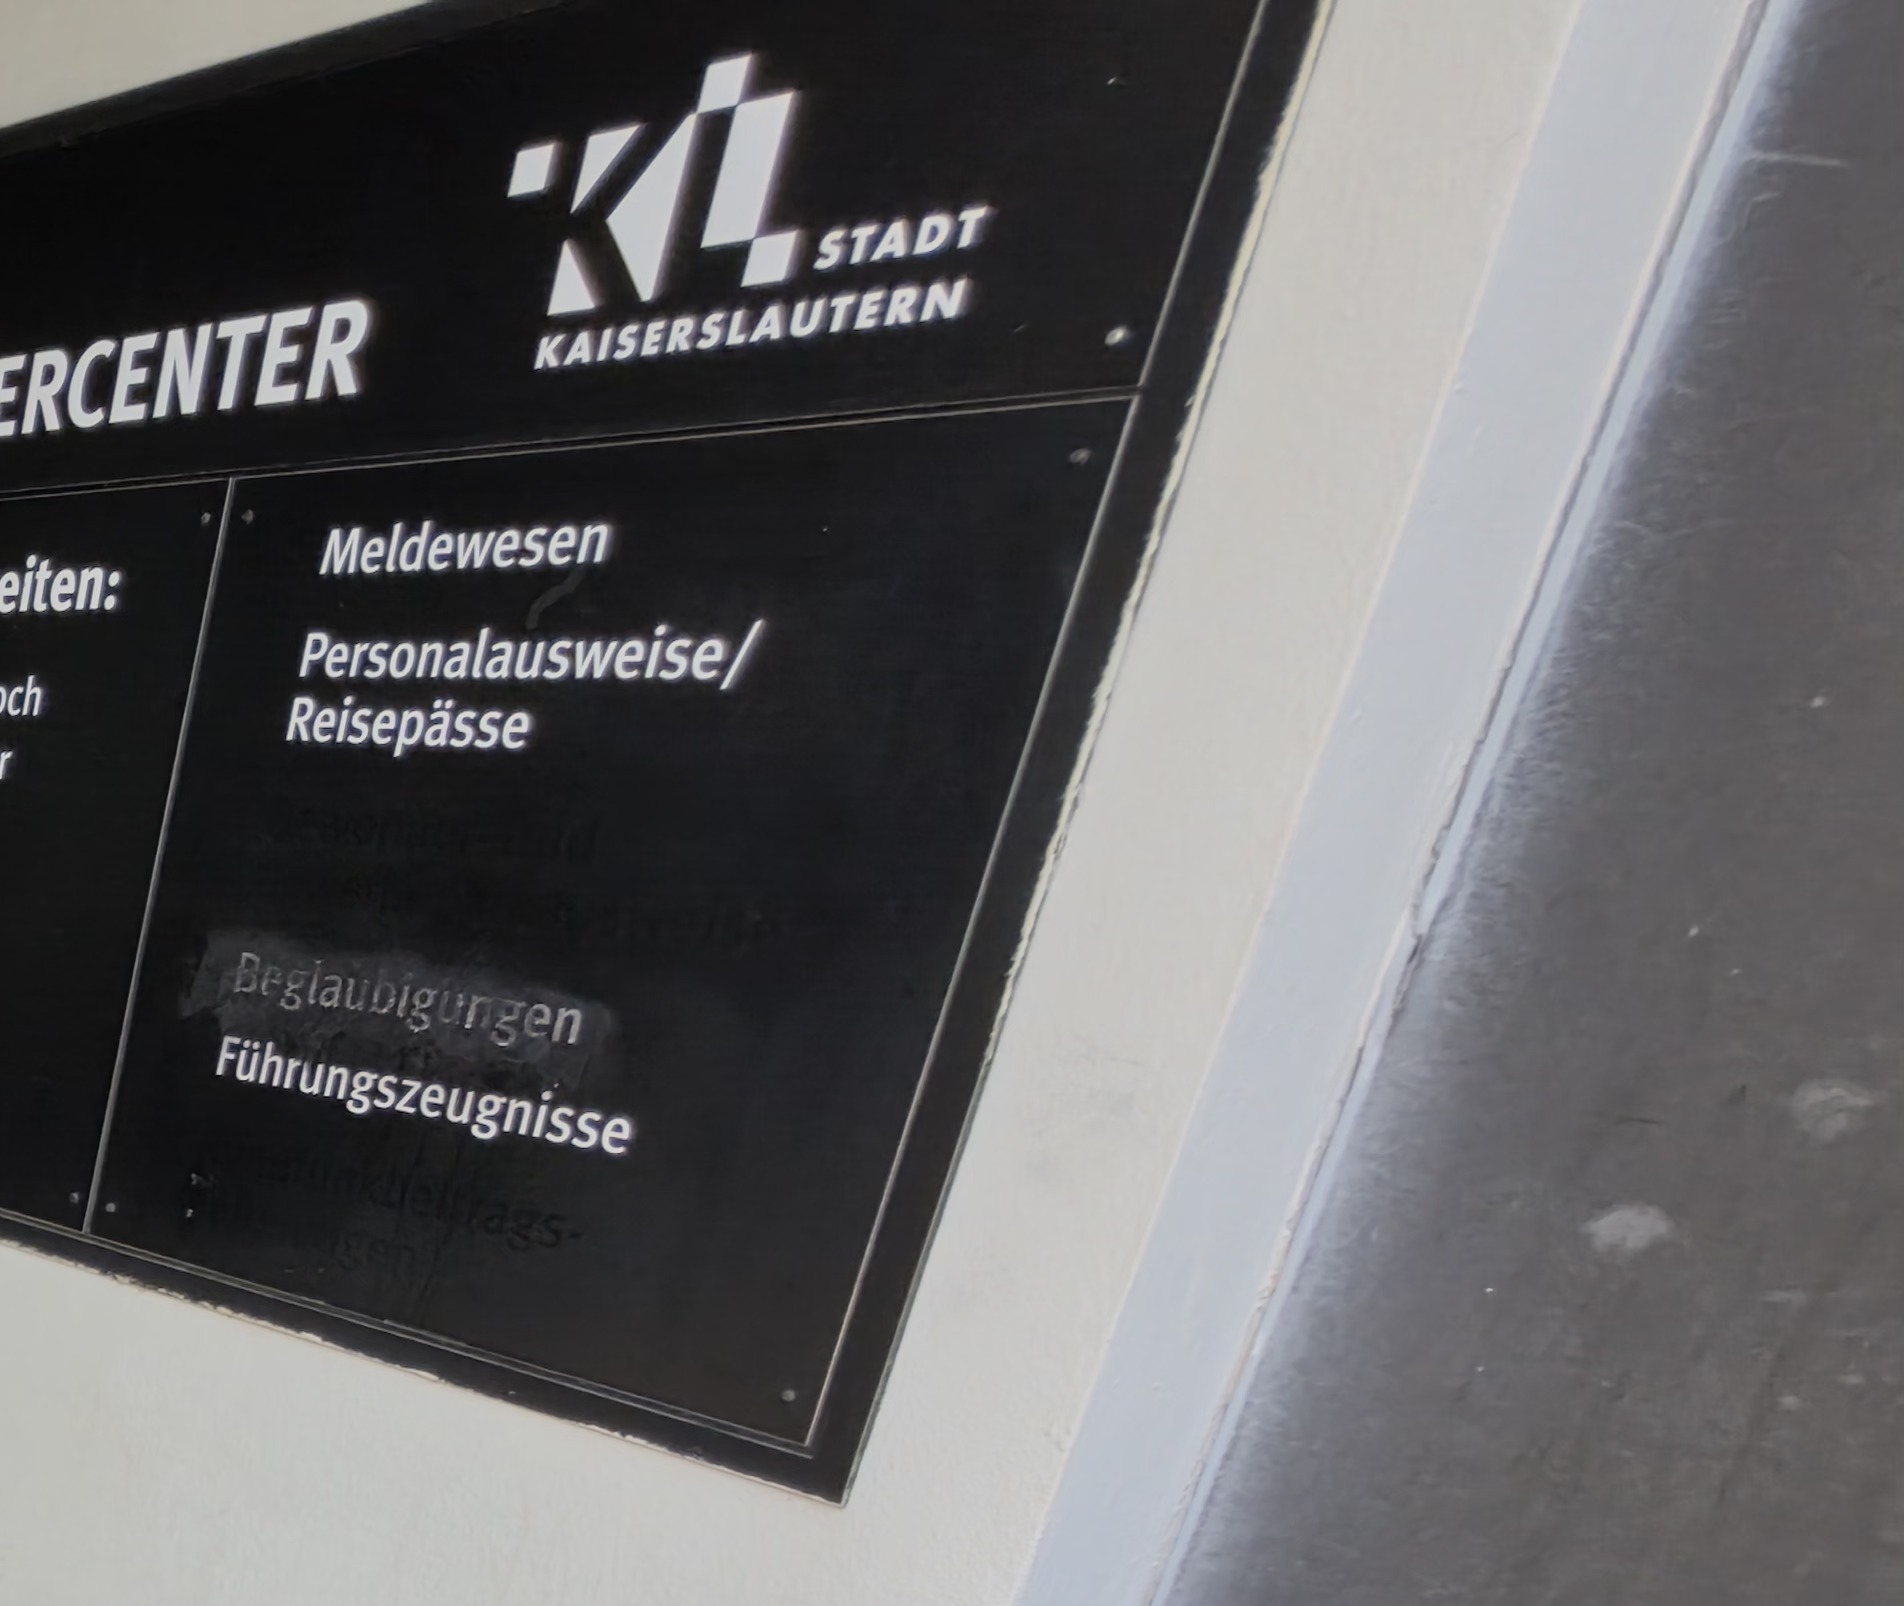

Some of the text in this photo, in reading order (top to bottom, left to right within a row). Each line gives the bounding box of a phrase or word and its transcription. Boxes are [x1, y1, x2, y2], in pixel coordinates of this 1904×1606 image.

[812, 204, 991, 271] STADT
[533, 274, 971, 370] KAISERSLAUTERN
[318, 519, 613, 575] Meldewesen
[298, 618, 762, 691] Personalausweise/
[285, 695, 533, 758] Reisepässe
[233, 951, 582, 1047] Beglaubigungen
[215, 1033, 634, 1155] Führungszeugnisse
